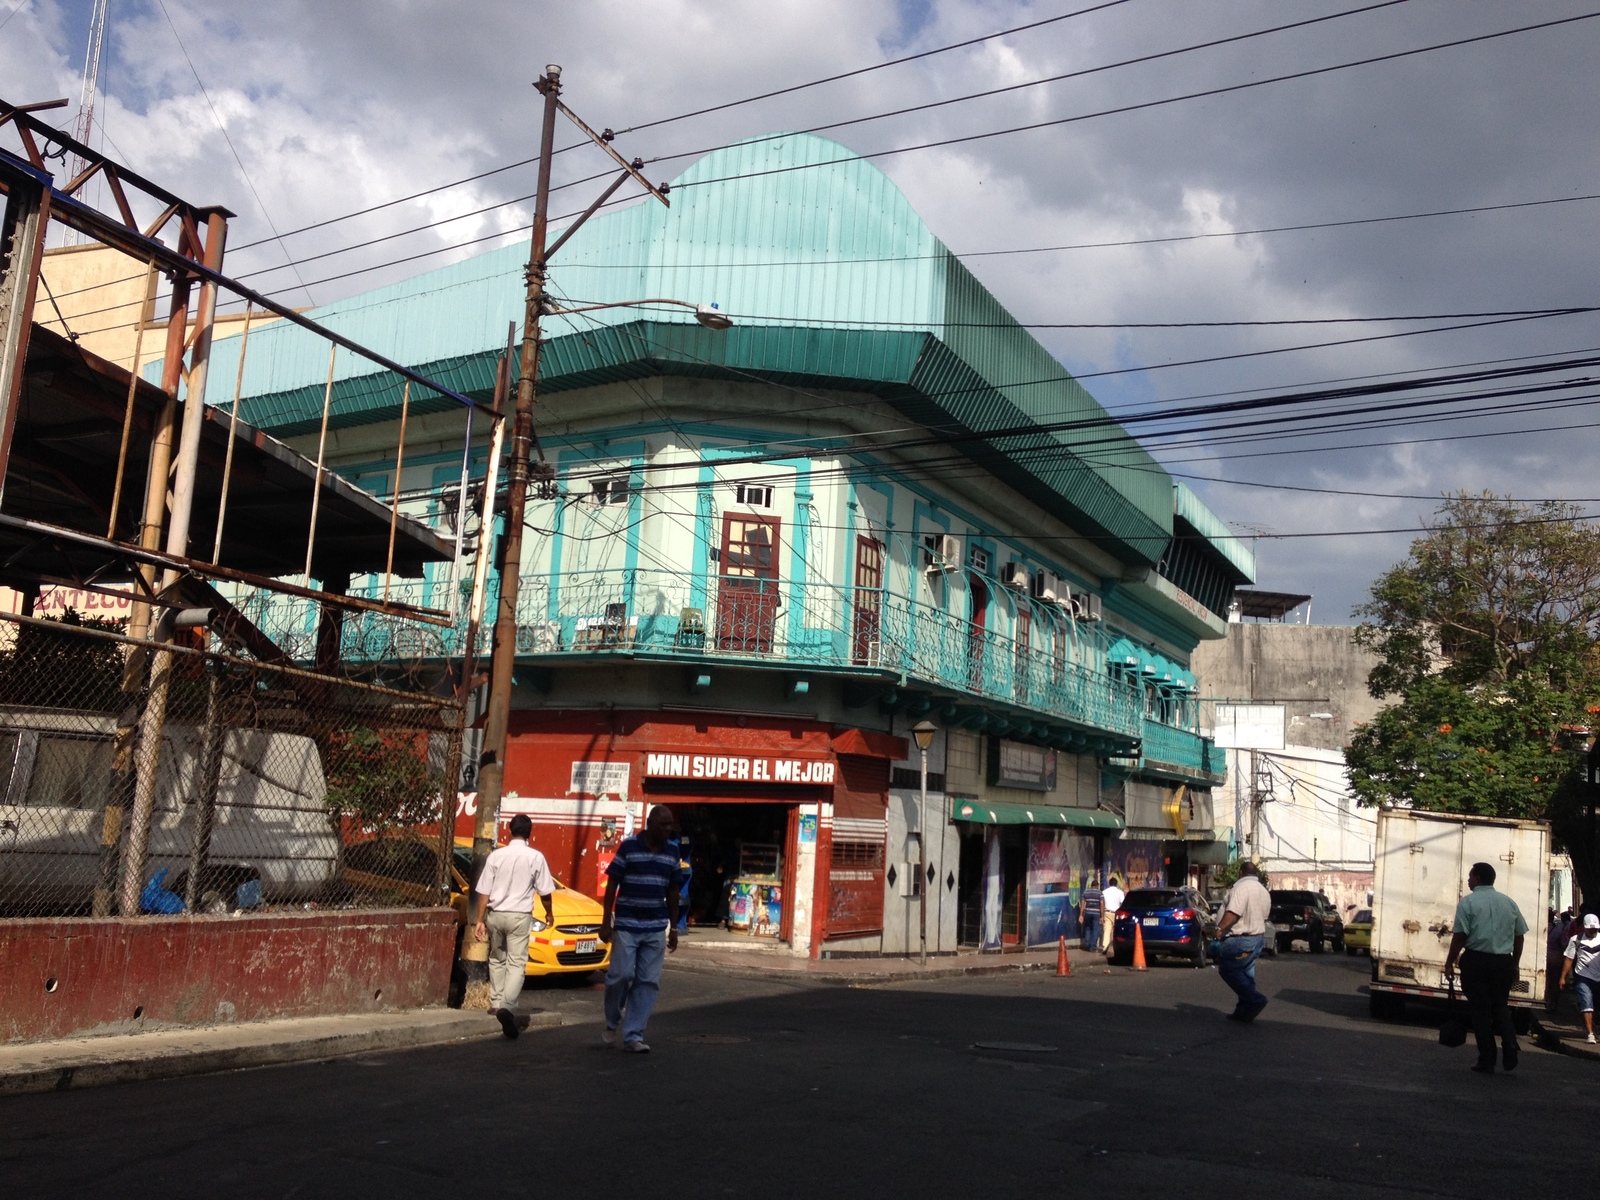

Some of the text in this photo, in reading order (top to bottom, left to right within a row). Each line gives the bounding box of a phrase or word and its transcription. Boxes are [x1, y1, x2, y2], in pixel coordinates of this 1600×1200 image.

[647, 753, 835, 783] MINI SUPER EL MEJOR
